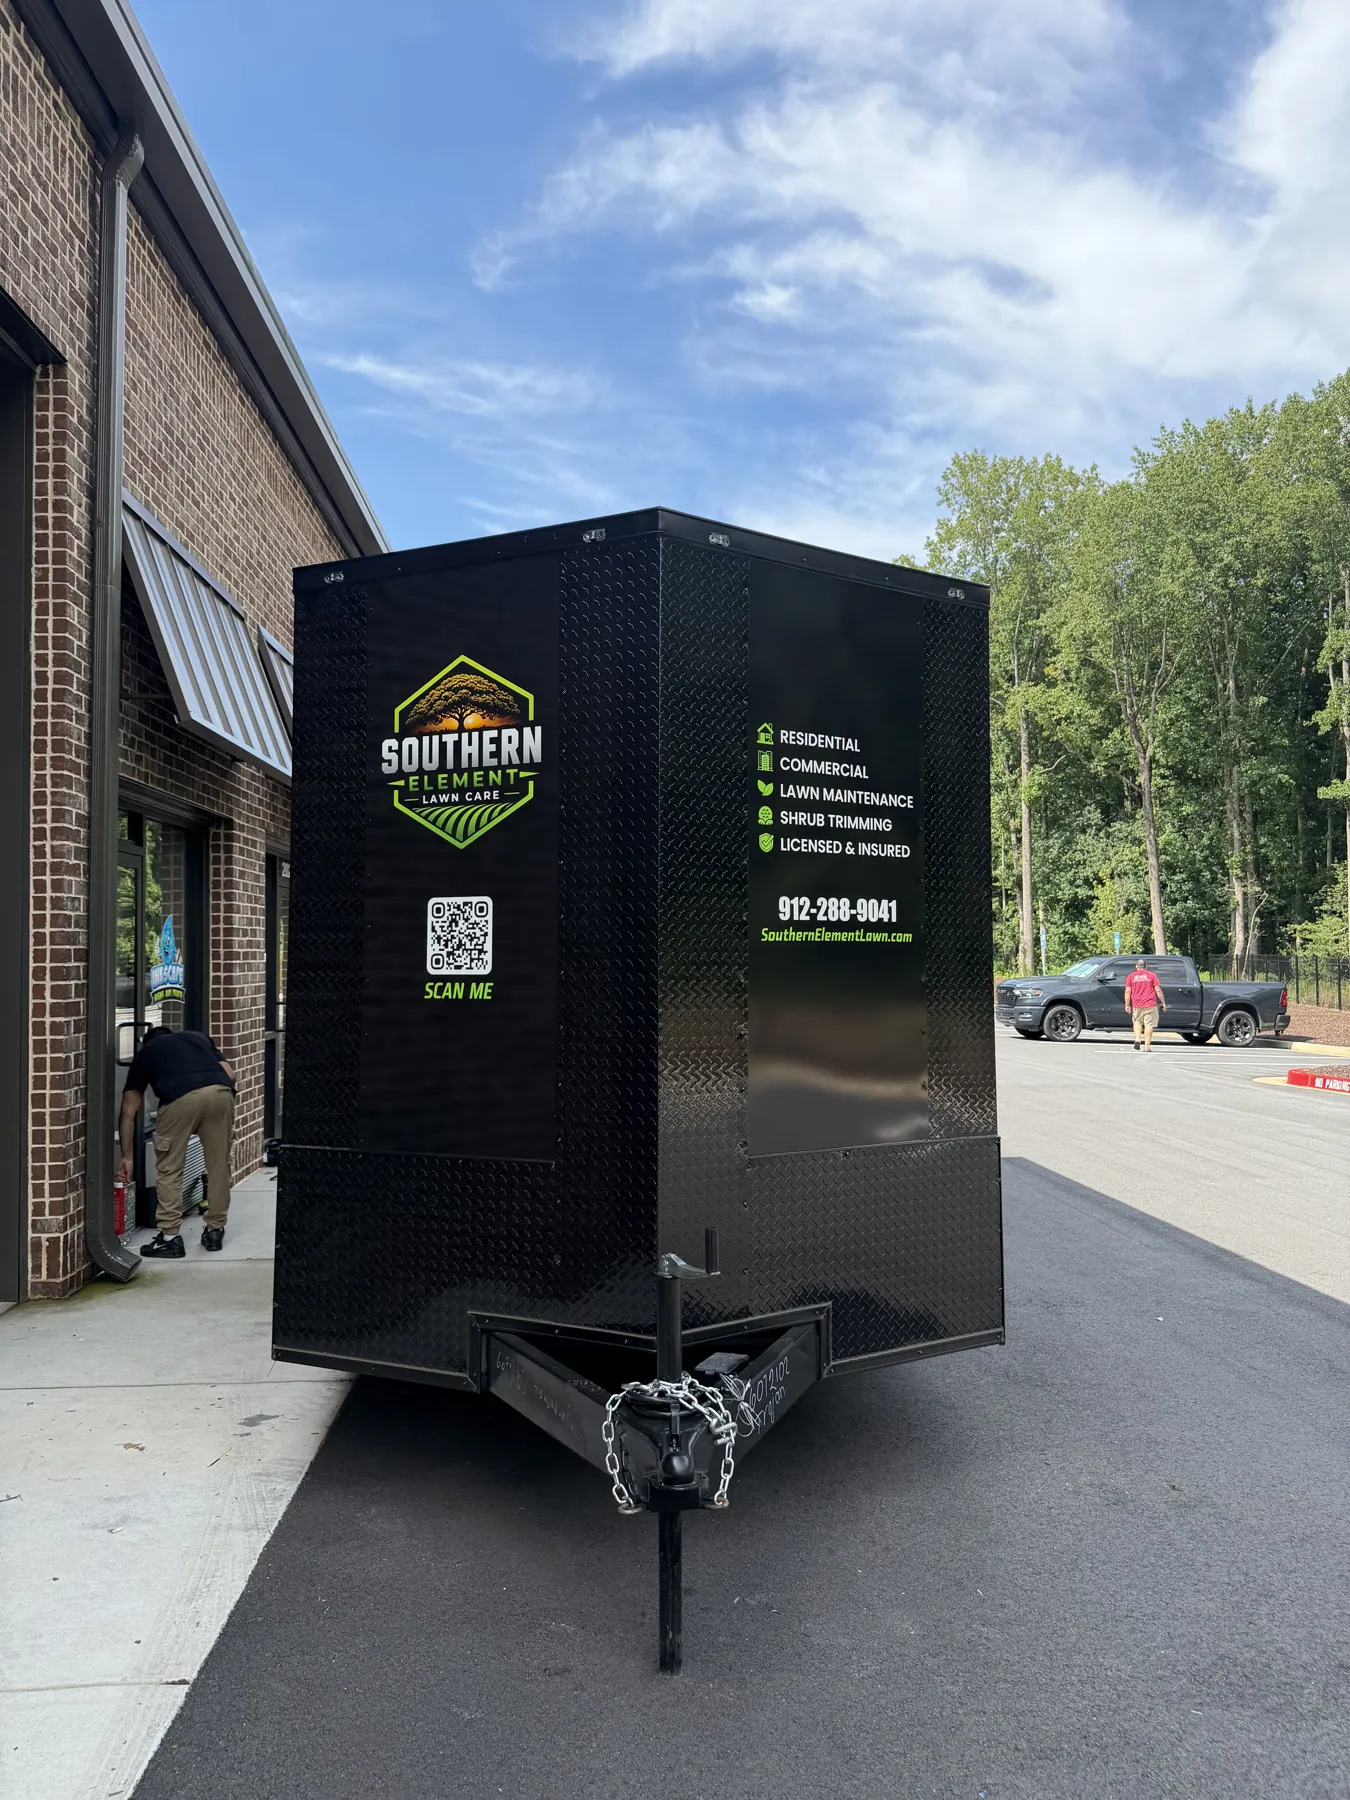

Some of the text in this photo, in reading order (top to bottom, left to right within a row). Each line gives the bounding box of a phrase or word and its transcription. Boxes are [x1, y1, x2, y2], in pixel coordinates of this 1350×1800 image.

[382, 726, 541, 774] SOUTHERN
[781, 730, 860, 752] RESIDENTIAL
[780, 757, 868, 779] COMMERCIAL
[408, 769, 518, 791] ELEMENT
[423, 790, 499, 804] LAWN CARE
[781, 784, 913, 808] LAWN MAINTENANCE
[781, 811, 892, 831] SHRUB TRIMMING
[781, 838, 910, 857] LICENSED & INSURED
[779, 896, 896, 922] 912-288-9041
[761, 927, 912, 942] SouthernElementLawn.com
[424, 983, 493, 999] SCAN ME
[1315, 1078, 1324, 1088] NO
